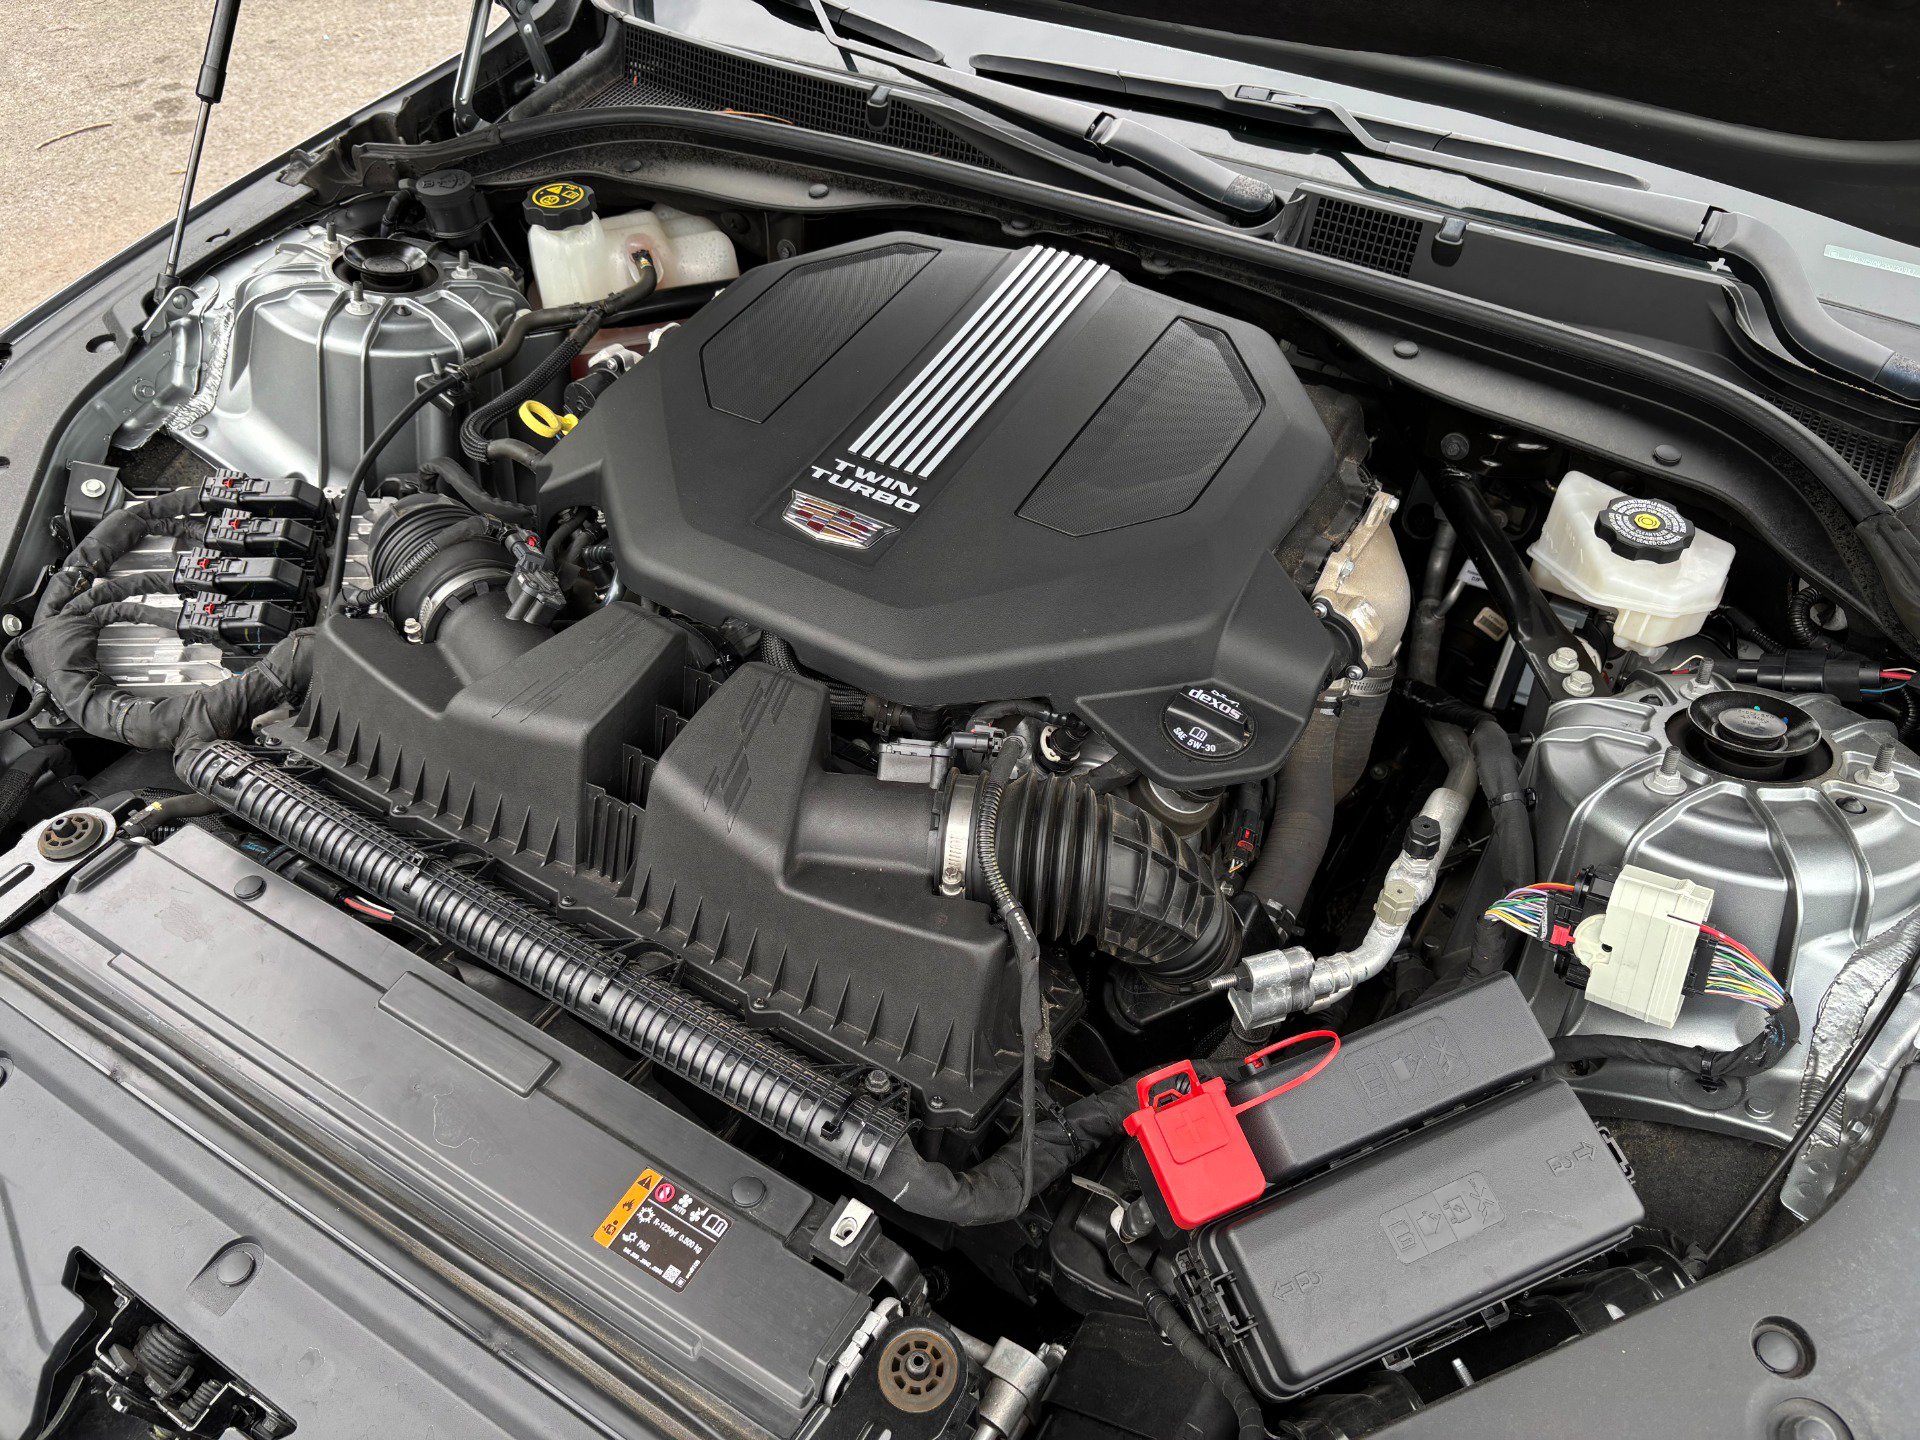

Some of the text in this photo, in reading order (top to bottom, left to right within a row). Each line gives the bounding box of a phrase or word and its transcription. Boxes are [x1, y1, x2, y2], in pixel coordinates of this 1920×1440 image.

[811, 465, 921, 514] TURBO
[834, 458, 918, 497] TWIN
[1188, 689, 1243, 720] dexos
[1173, 727, 1216, 752] SAE 5W-30
[671, 1203, 687, 1216] AUTO
[636, 1239, 651, 1253] PAG
[653, 1218, 680, 1238] R-1234yf
[693, 1243, 703, 1255] kg
